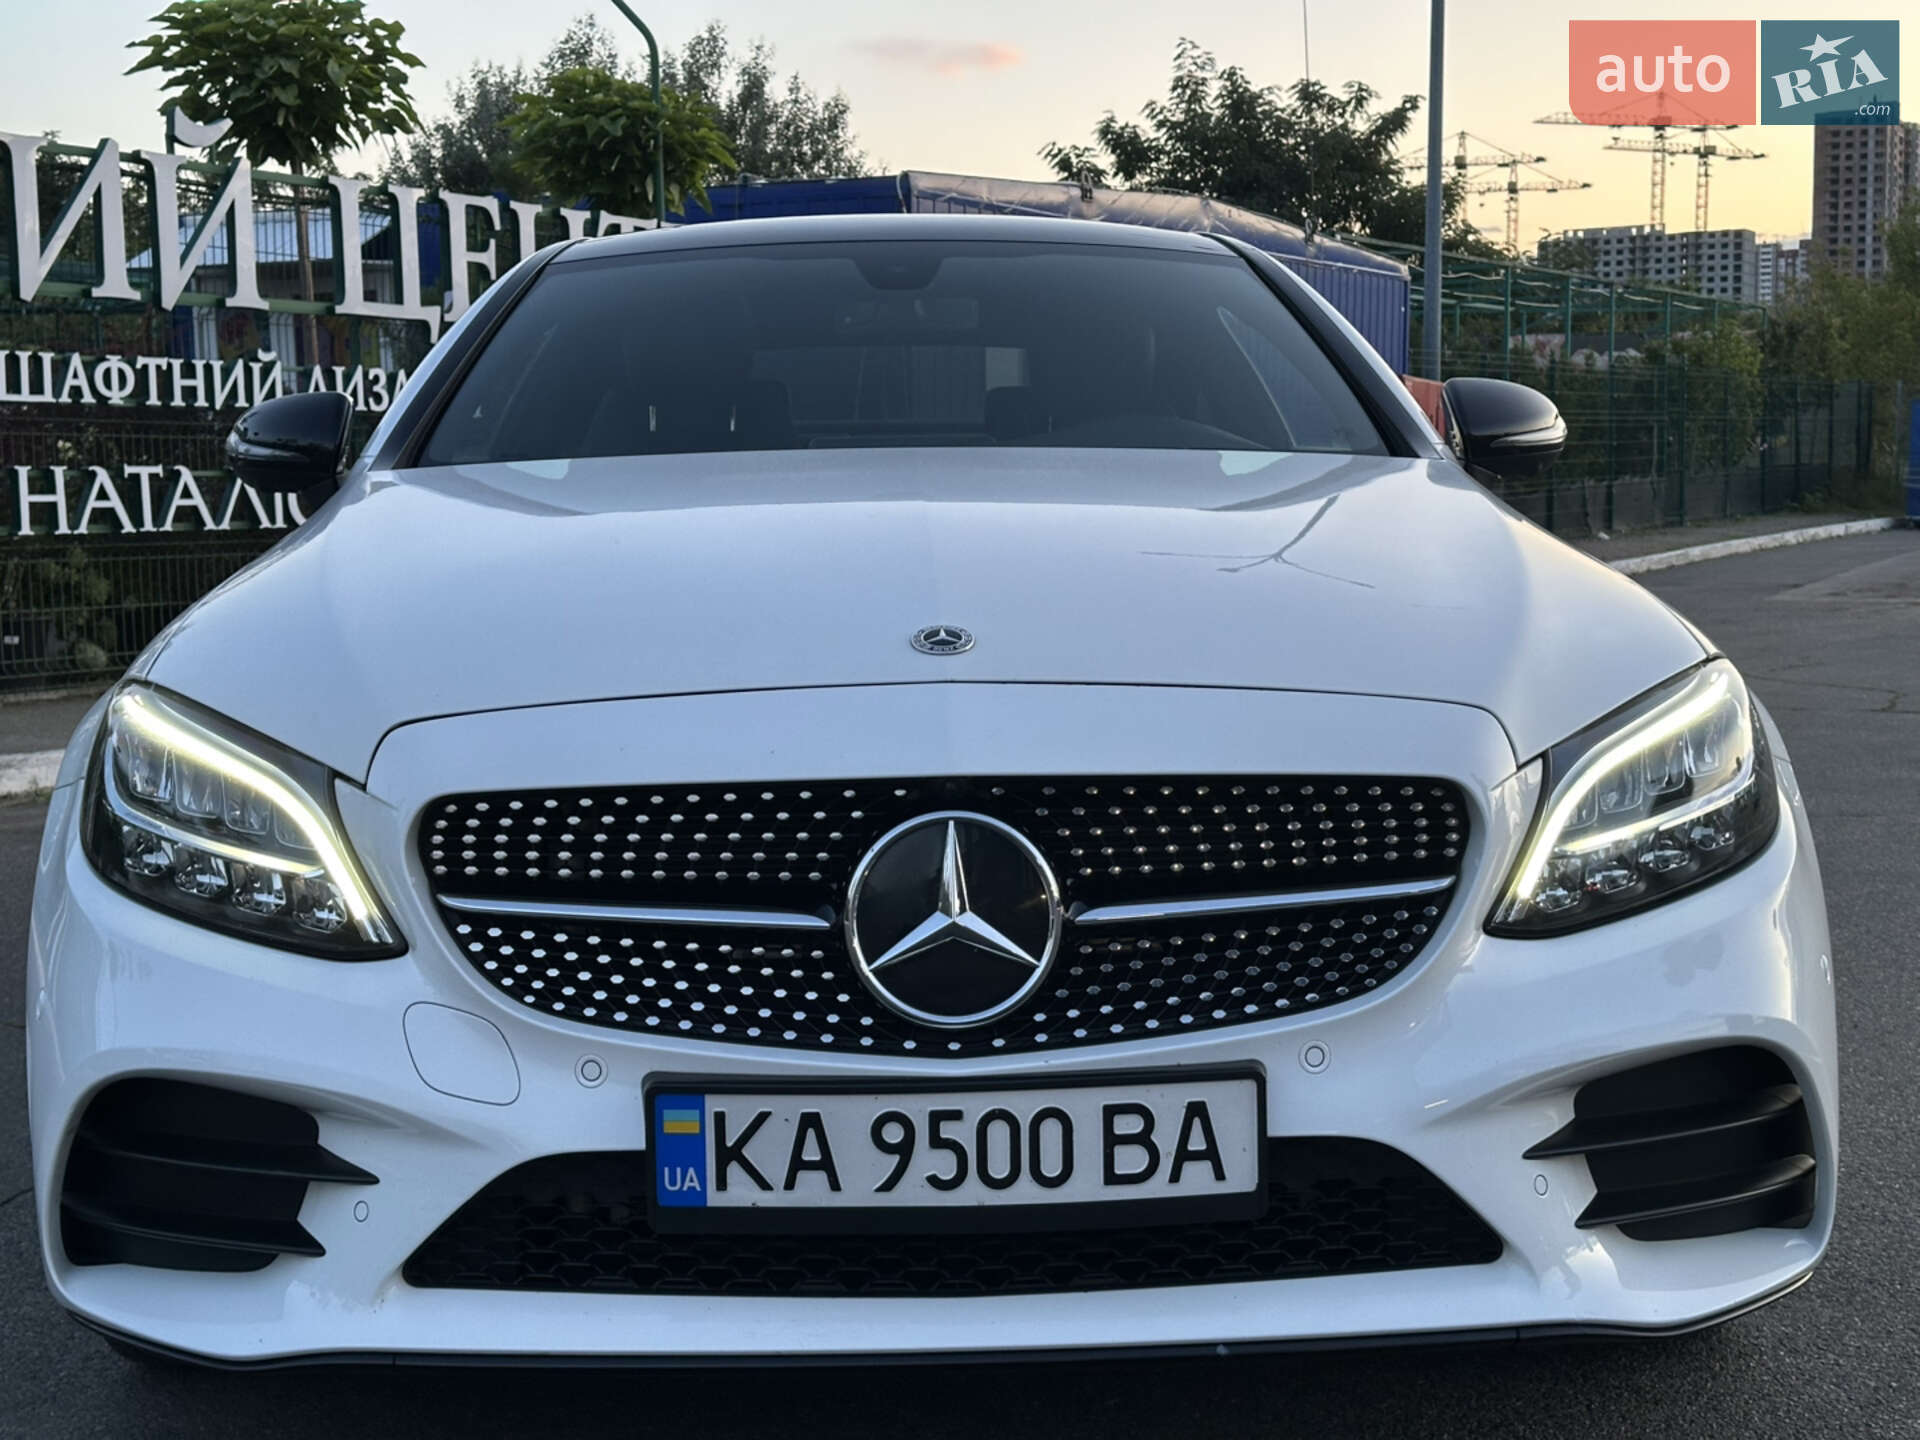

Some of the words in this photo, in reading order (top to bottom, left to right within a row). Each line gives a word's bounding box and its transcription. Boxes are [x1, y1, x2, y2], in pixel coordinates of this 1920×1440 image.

[713, 1109, 842, 1192] KA
[870, 1106, 1074, 1192] 9500
[1103, 1099, 1227, 1186] BA
[663, 1166, 702, 1192] UA
